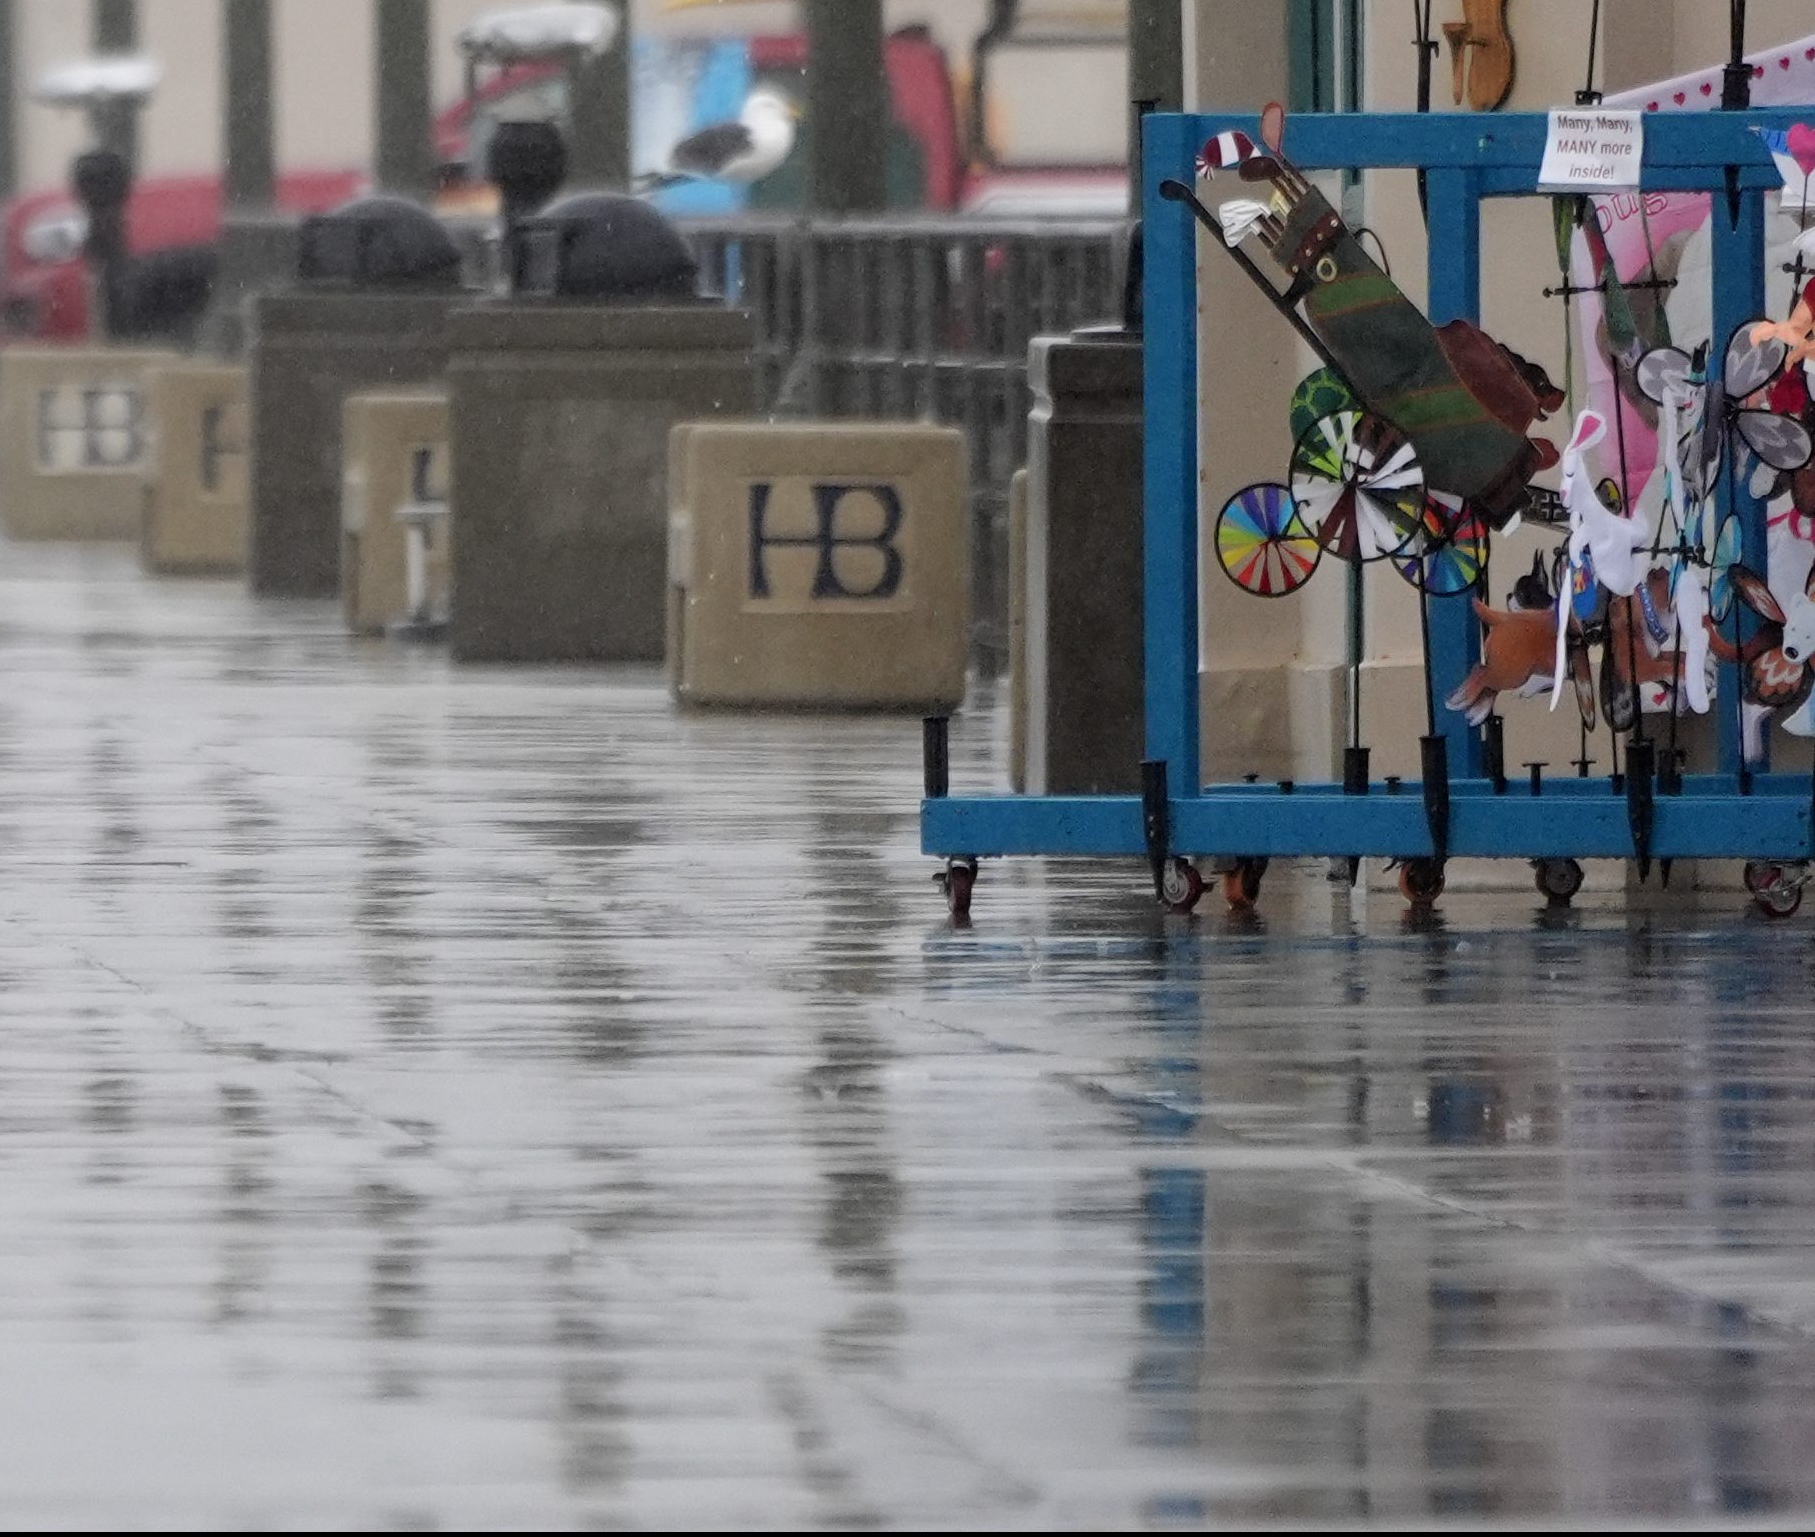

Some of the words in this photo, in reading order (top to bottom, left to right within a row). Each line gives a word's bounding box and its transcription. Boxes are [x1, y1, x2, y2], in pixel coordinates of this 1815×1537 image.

[1557, 115, 1593, 133] Many,
[1597, 116, 1633, 134] Many,
[1557, 140, 1597, 155] MANY
[1600, 143, 1632, 156] more
[1569, 164, 1615, 179] inside!
[38, 387, 150, 467] HB
[748, 482, 905, 600] HB
